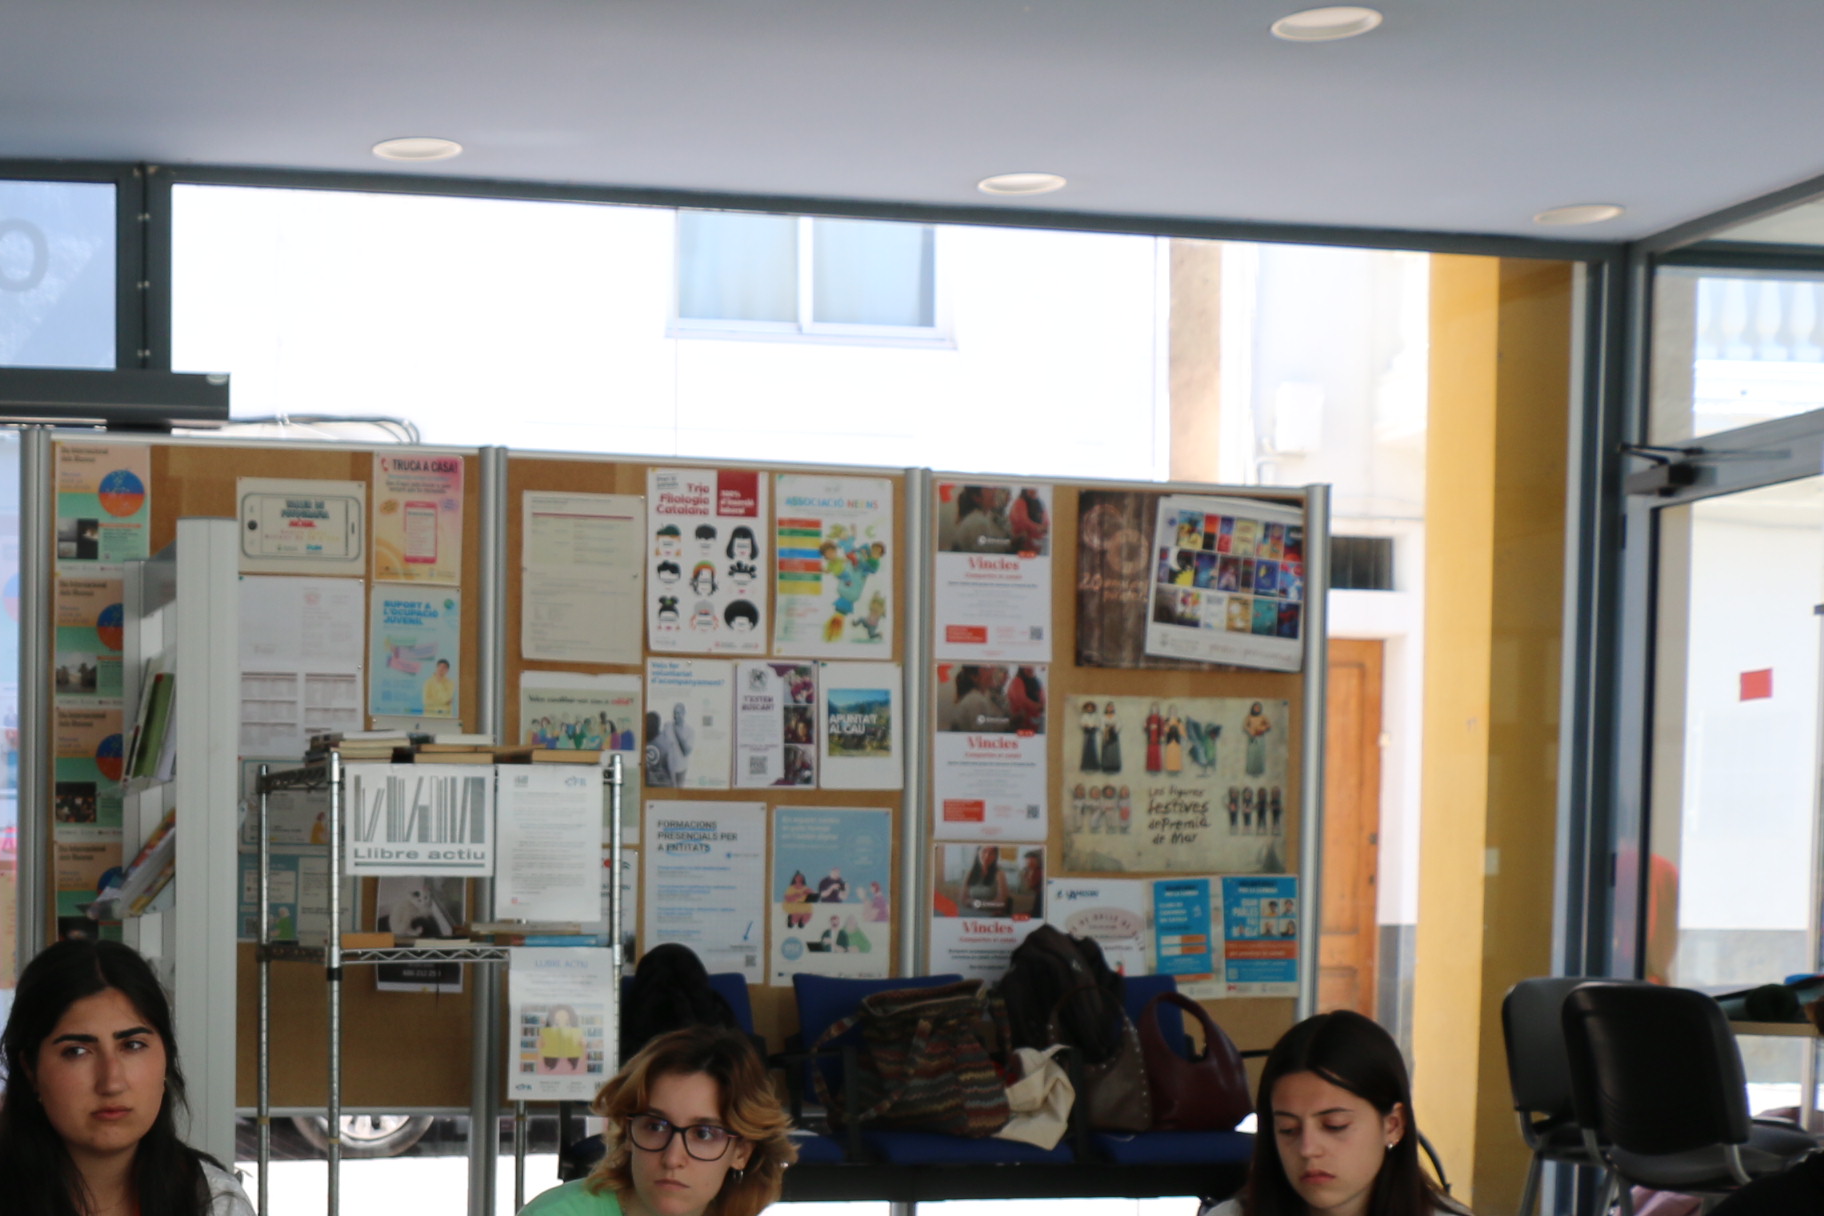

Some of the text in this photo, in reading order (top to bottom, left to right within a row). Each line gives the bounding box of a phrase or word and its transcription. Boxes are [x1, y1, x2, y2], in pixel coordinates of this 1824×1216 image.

[392, 458, 458, 473] TRUCA A CASA!
[968, 557, 1020, 570] Vincles
[383, 600, 422, 608] SUPORT
[829, 724, 866, 734] AL CAU
[967, 736, 1019, 749] Vincles
[657, 820, 718, 829] FORMACIONS
[657, 832, 738, 841] PRESENCIALS PER
[1171, 832, 1198, 844] Mar
[657, 843, 711, 852] A ENTITATS
[354, 847, 486, 860] Llibre actiu
[962, 921, 1014, 934] Vincles
[565, 960, 589, 968] ACTIU
